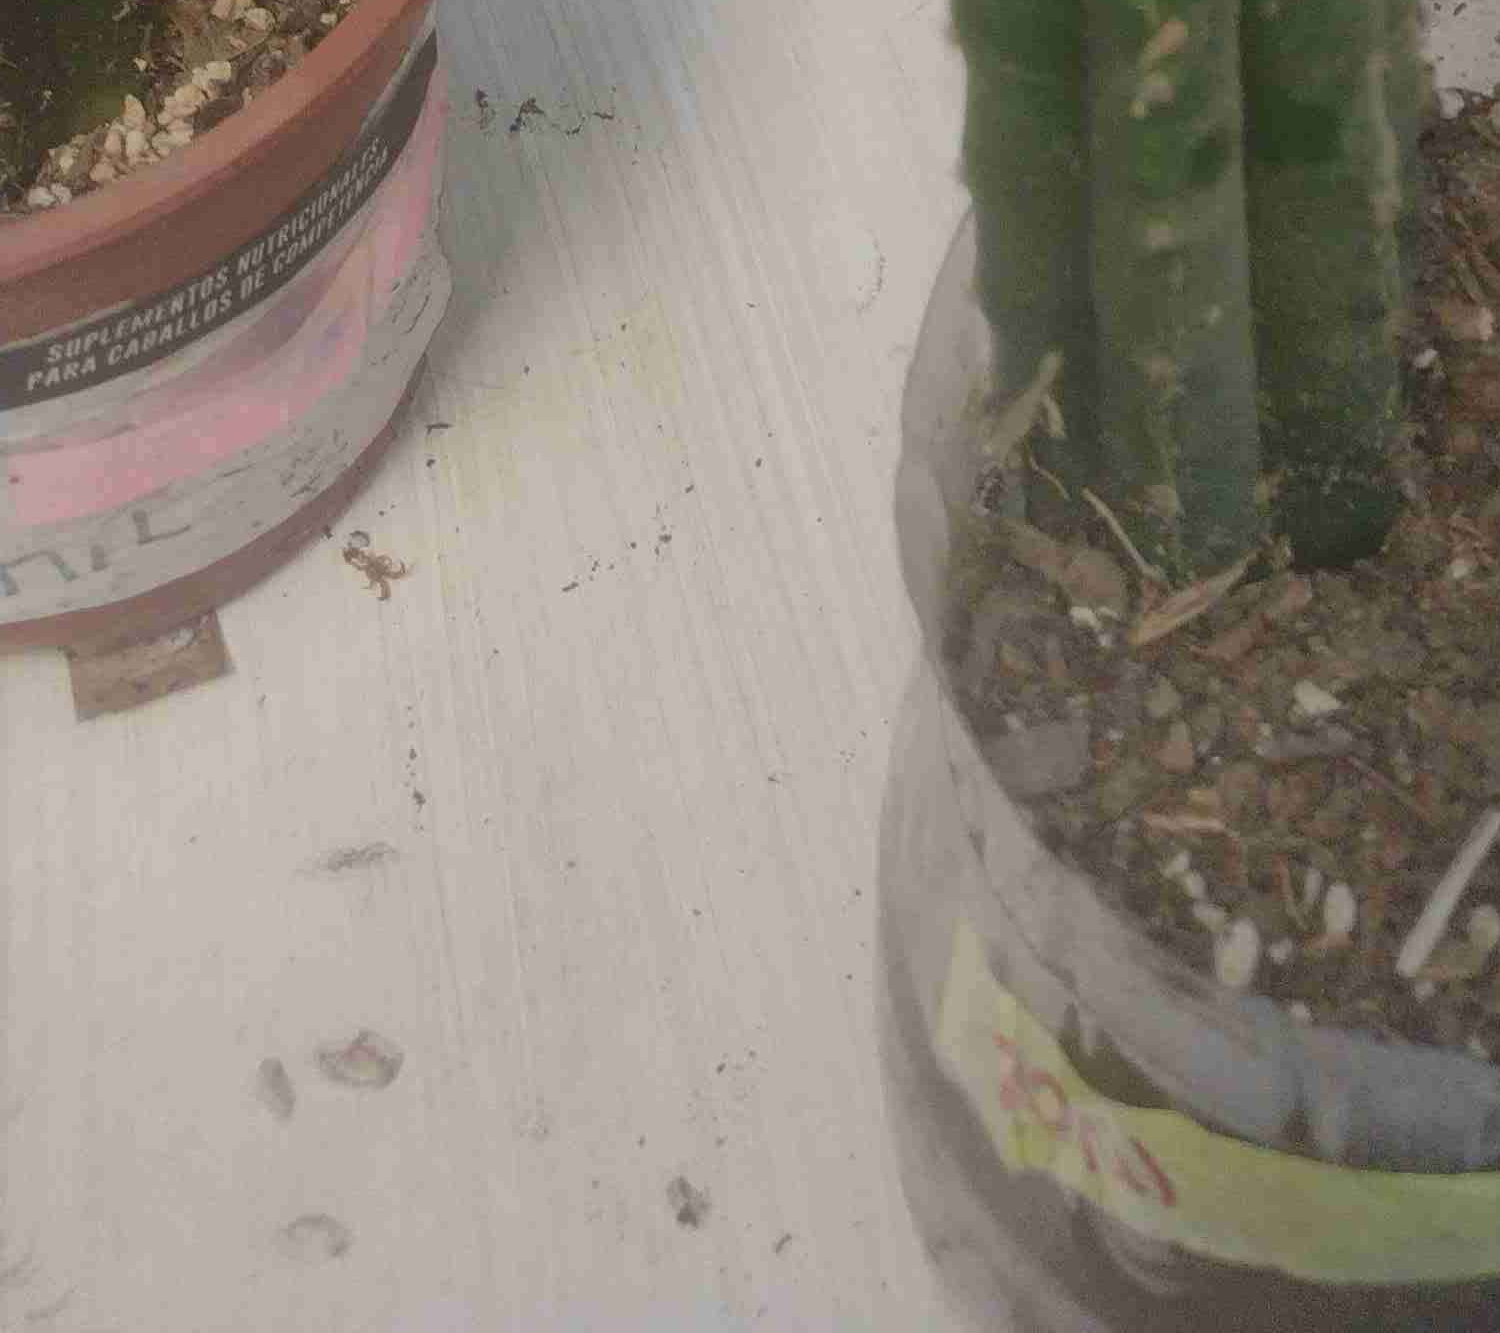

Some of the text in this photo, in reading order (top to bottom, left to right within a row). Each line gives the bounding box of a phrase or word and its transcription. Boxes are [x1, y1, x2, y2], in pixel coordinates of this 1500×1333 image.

[27, 356, 97, 391] PARA
[107, 289, 233, 366] CABALLOS
[240, 266, 265, 299] DE
[48, 265, 229, 363] SUPLEMENTOS
